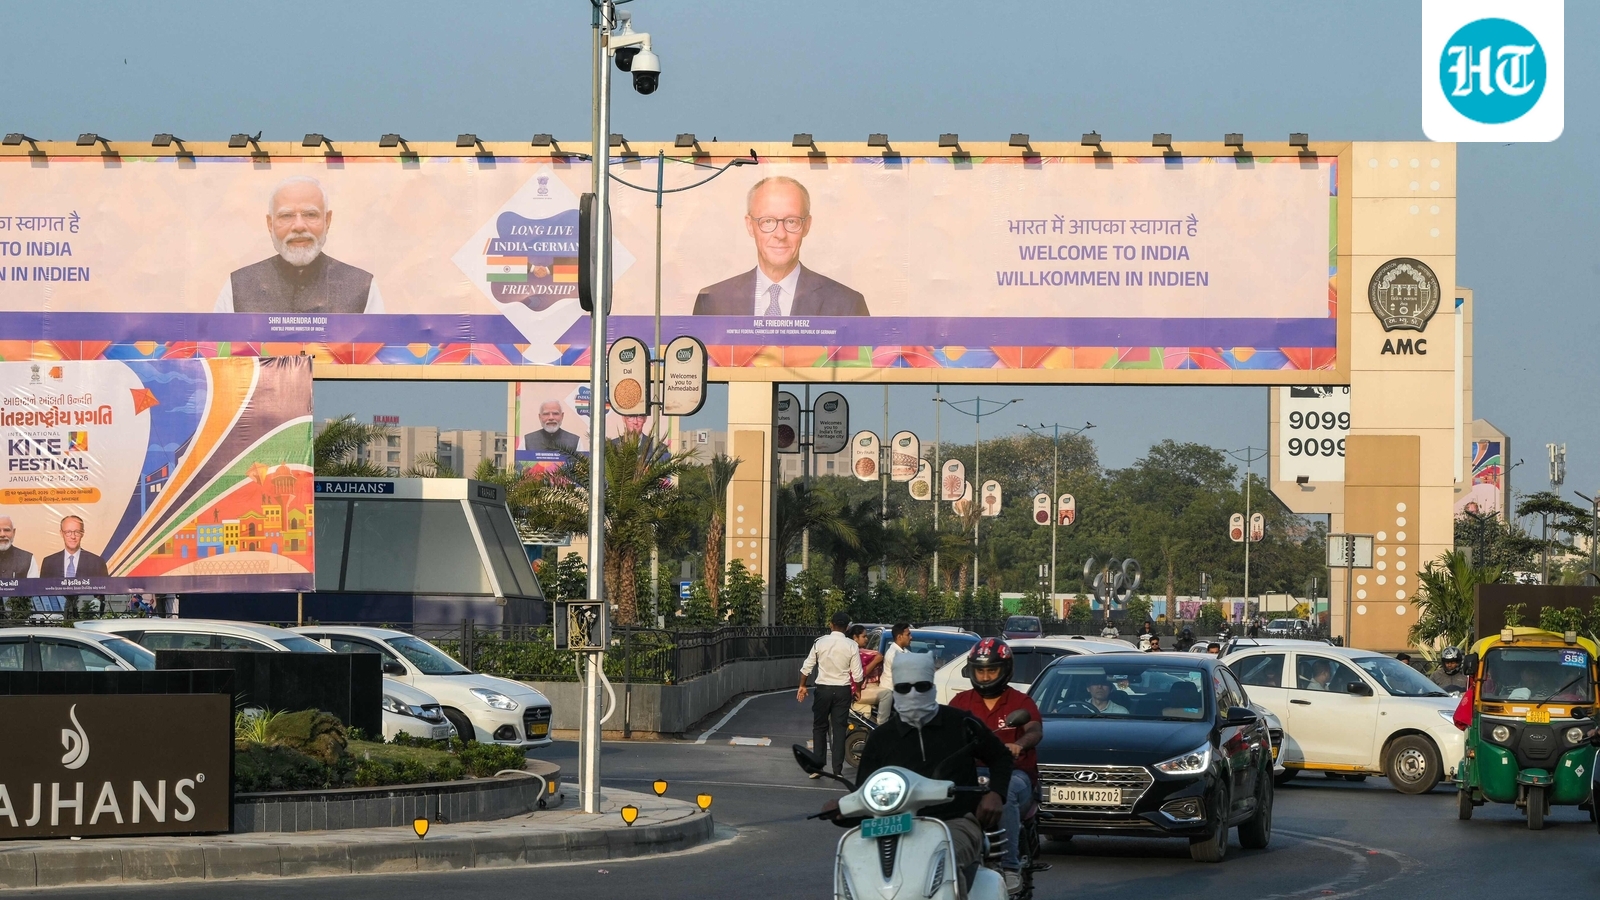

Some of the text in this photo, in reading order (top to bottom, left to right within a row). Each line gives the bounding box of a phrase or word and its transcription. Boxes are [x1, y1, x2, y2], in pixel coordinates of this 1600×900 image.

[15, 216, 65, 232] स्वागत
[68, 210, 81, 234] है
[1007, 212, 1199, 237] भारत में आपका स्वागत है
[510, 225, 575, 237] LONG LIVE
[0, 241, 72, 257] TO INDIA
[1018, 245, 1190, 261] WELCOME TO INDIA
[11, 267, 28, 282] IN
[32, 267, 90, 282] INDIEN
[996, 270, 1209, 287] WILLKOMMEN IN INDIEN
[501, 284, 576, 296] FRIENDSHIP
[268, 316, 328, 325] SHRI NARENDRA MODI
[754, 319, 810, 327] MR. FRIEDRICH MERZ
[1381, 338, 1428, 355] AMC
[74, 405, 112, 425] પ્રગતિ
[1289, 411, 1350, 430] 9099
[8, 439, 61, 456] KITE
[9, 457, 88, 471] FESTIVAL
[326, 483, 385, 493] RAJHANS
[1564, 654, 1584, 664] 858
[1058, 790, 1119, 802] GJ01KW3202
[870, 823, 903, 836] L3700
